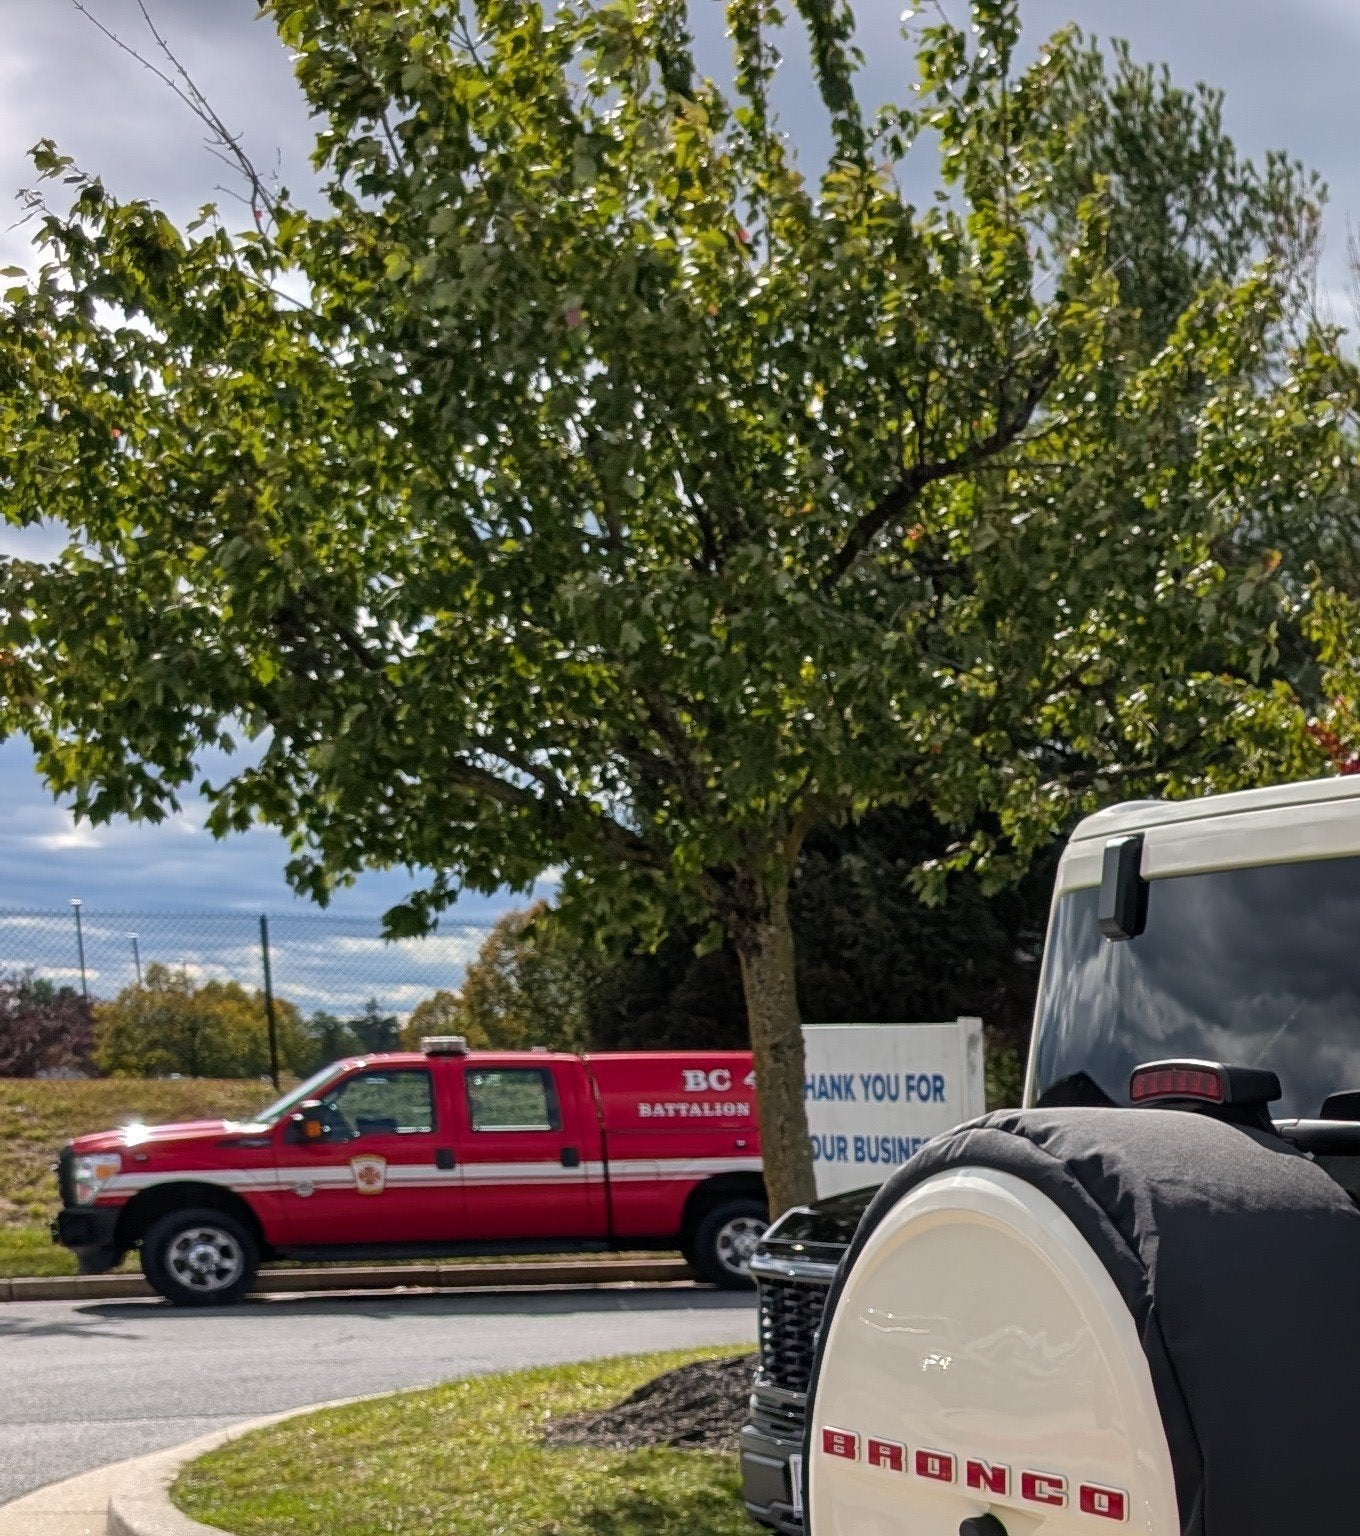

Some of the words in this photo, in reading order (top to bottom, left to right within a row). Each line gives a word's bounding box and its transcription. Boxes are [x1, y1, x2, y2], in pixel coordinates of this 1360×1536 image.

[682, 1068, 732, 1092] BC
[804, 1072, 857, 1104] HANK
[858, 1072, 900, 1104] YOU
[904, 1073, 947, 1104] FOR
[637, 1101, 751, 1118] BATTALION
[808, 1134, 849, 1164] OUR
[822, 1425, 1129, 1523] BRONCO
